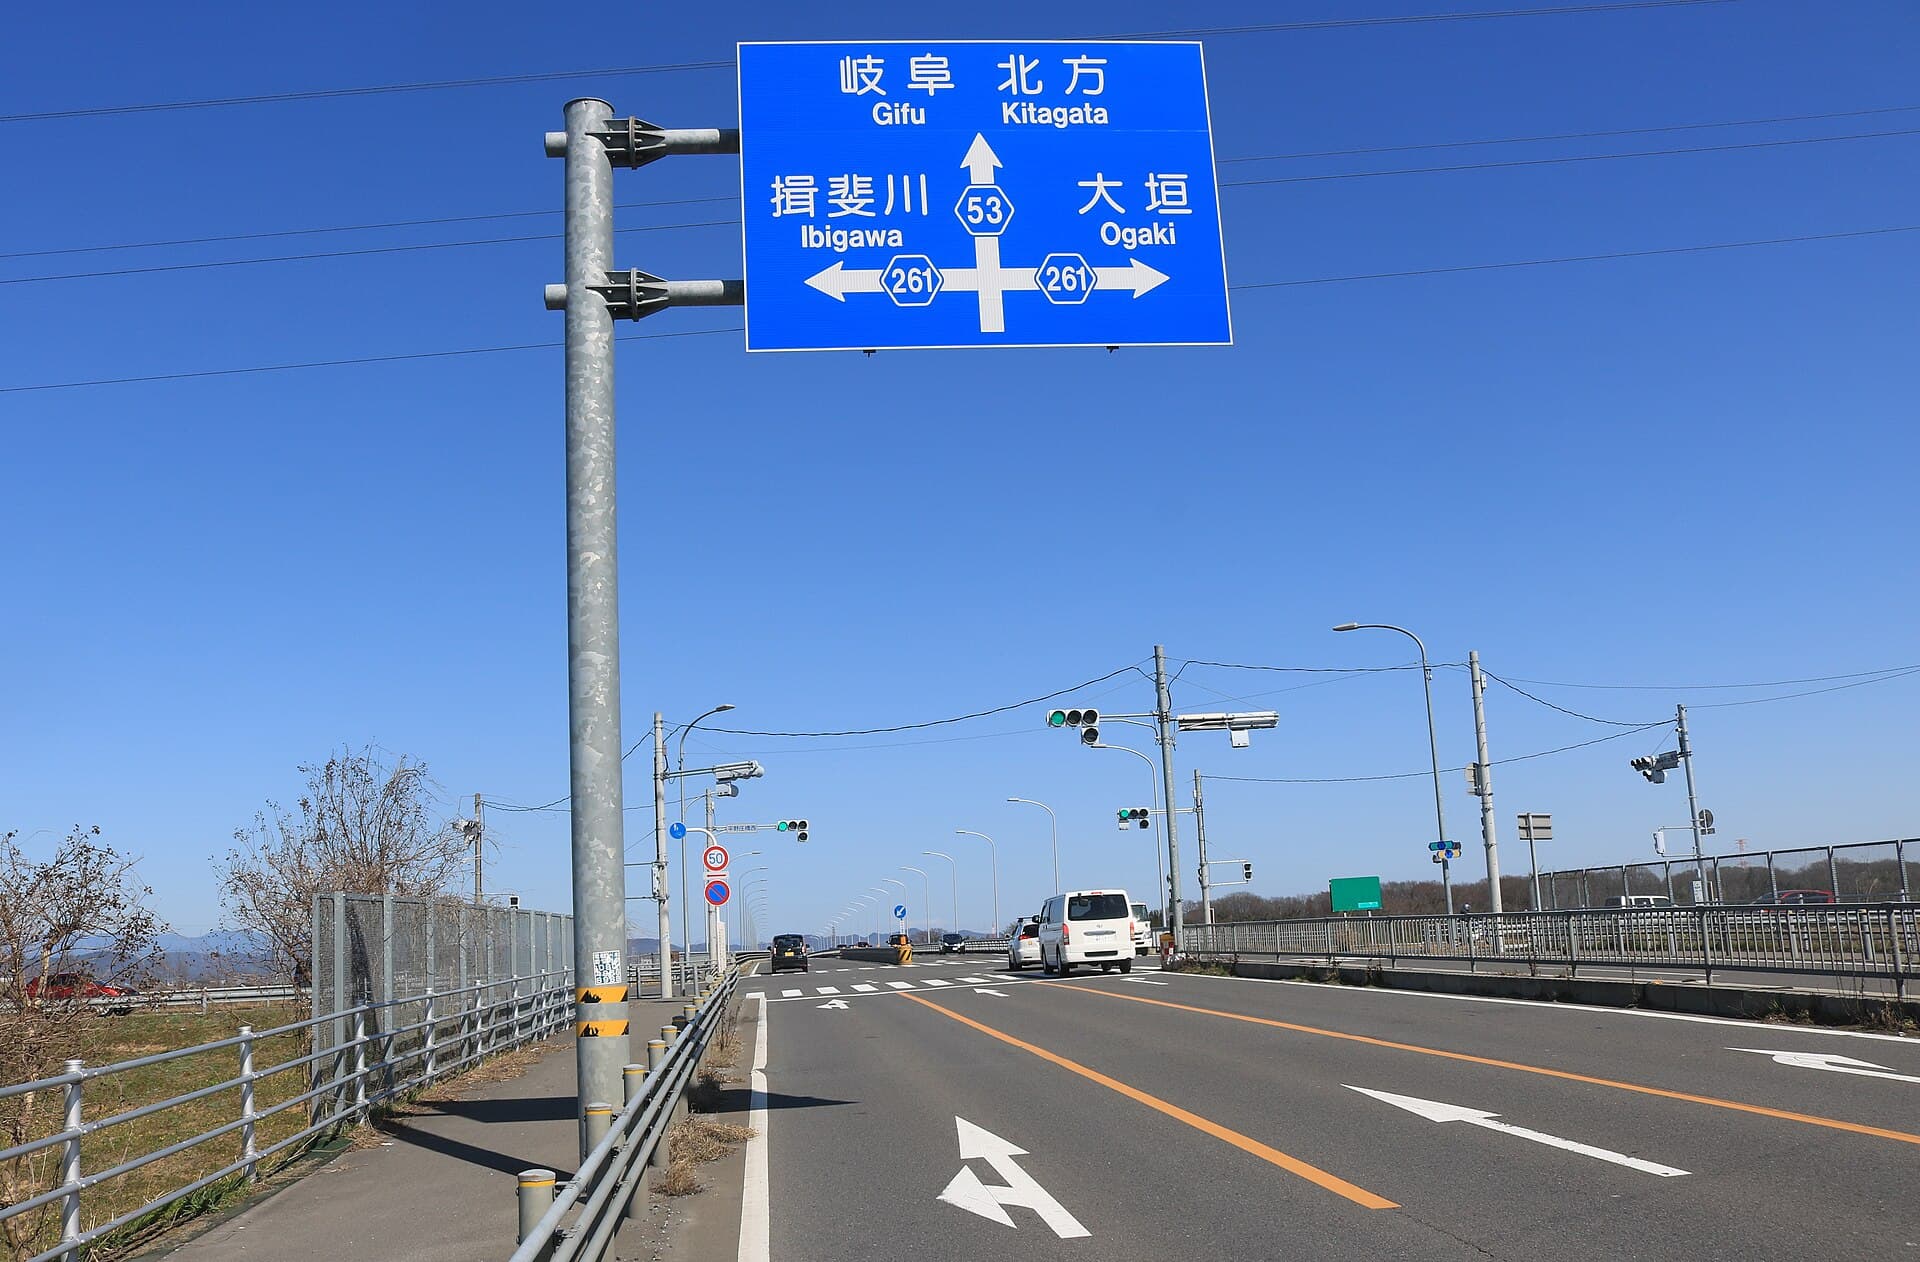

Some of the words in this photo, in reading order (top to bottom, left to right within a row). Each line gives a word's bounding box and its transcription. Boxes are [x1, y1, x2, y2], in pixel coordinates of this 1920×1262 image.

[840, 53, 954, 96] 岐阜
[998, 55, 1107, 95] 北方
[873, 102, 925, 125] Gifu
[1002, 102, 1108, 128] Kitagata
[771, 174, 927, 217] 揖斐川
[1078, 173, 1192, 214] 大垣
[966, 195, 1004, 226] 53
[802, 225, 902, 252] Ibigawa
[1101, 222, 1175, 249] Ogaki
[891, 267, 934, 294] 261
[1046, 266, 1089, 292] 261
[709, 853, 723, 864] 50
